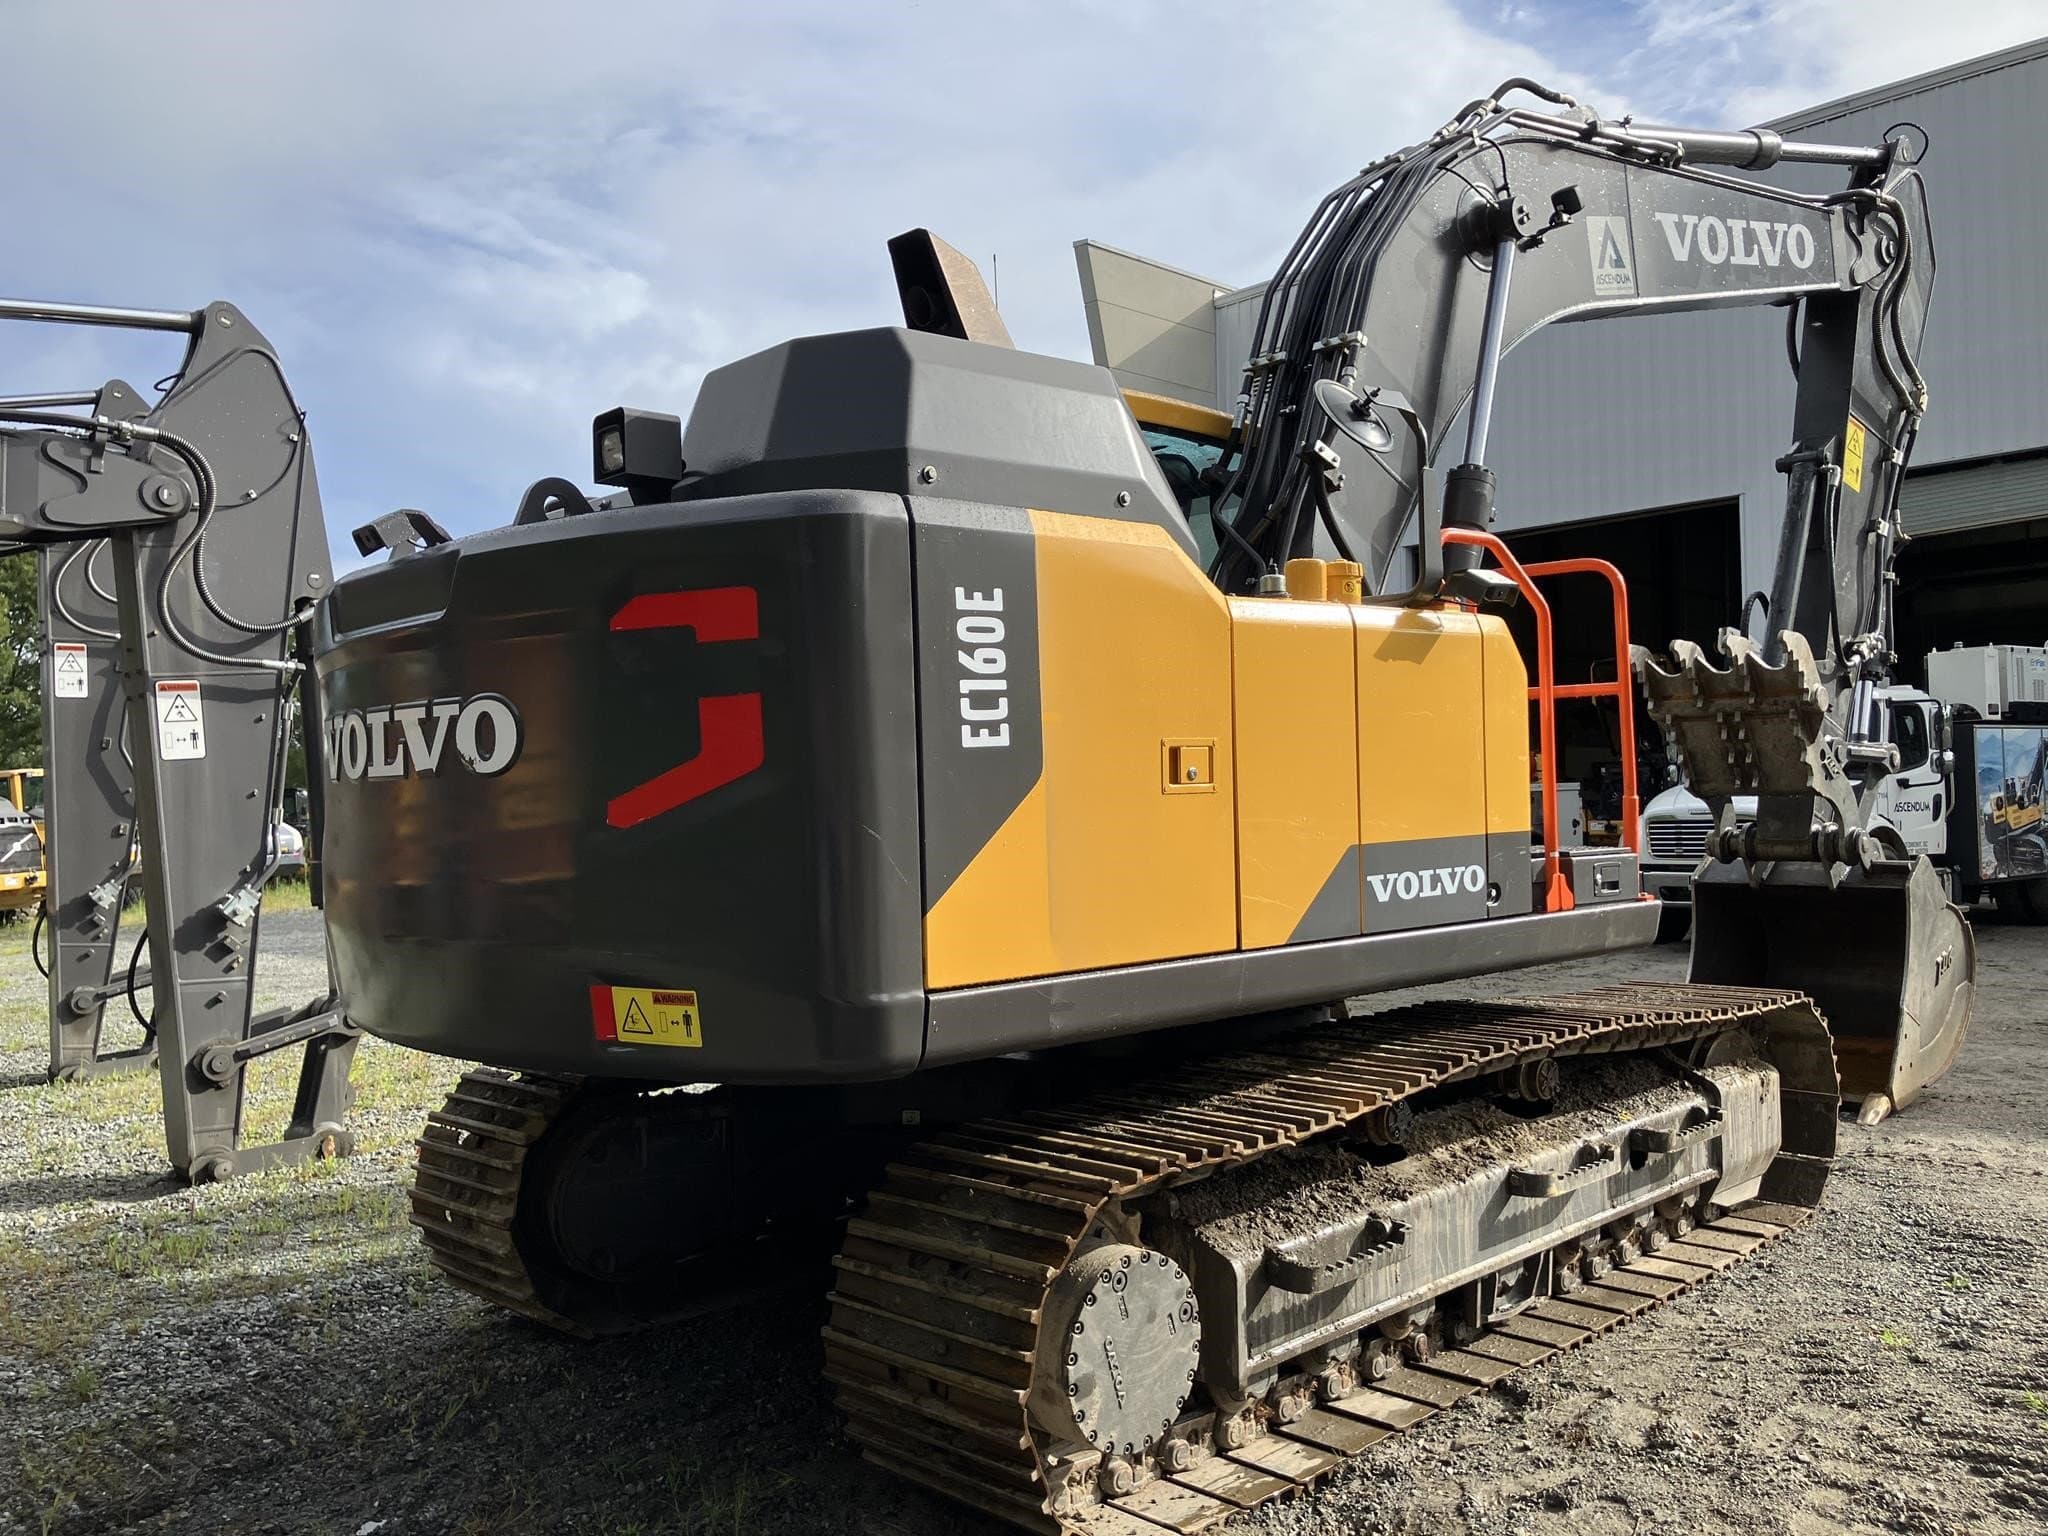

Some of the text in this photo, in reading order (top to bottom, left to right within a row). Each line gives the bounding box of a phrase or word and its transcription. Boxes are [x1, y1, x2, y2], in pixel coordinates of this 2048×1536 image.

[1654, 212, 1815, 270] VOLVO
[1596, 272, 1632, 285] ASCENDUM
[955, 586, 1010, 748] EC160E
[324, 697, 518, 784] VOLVO
[1894, 801, 1931, 812] ASCENDUM
[1366, 864, 1486, 903] VOLVO
